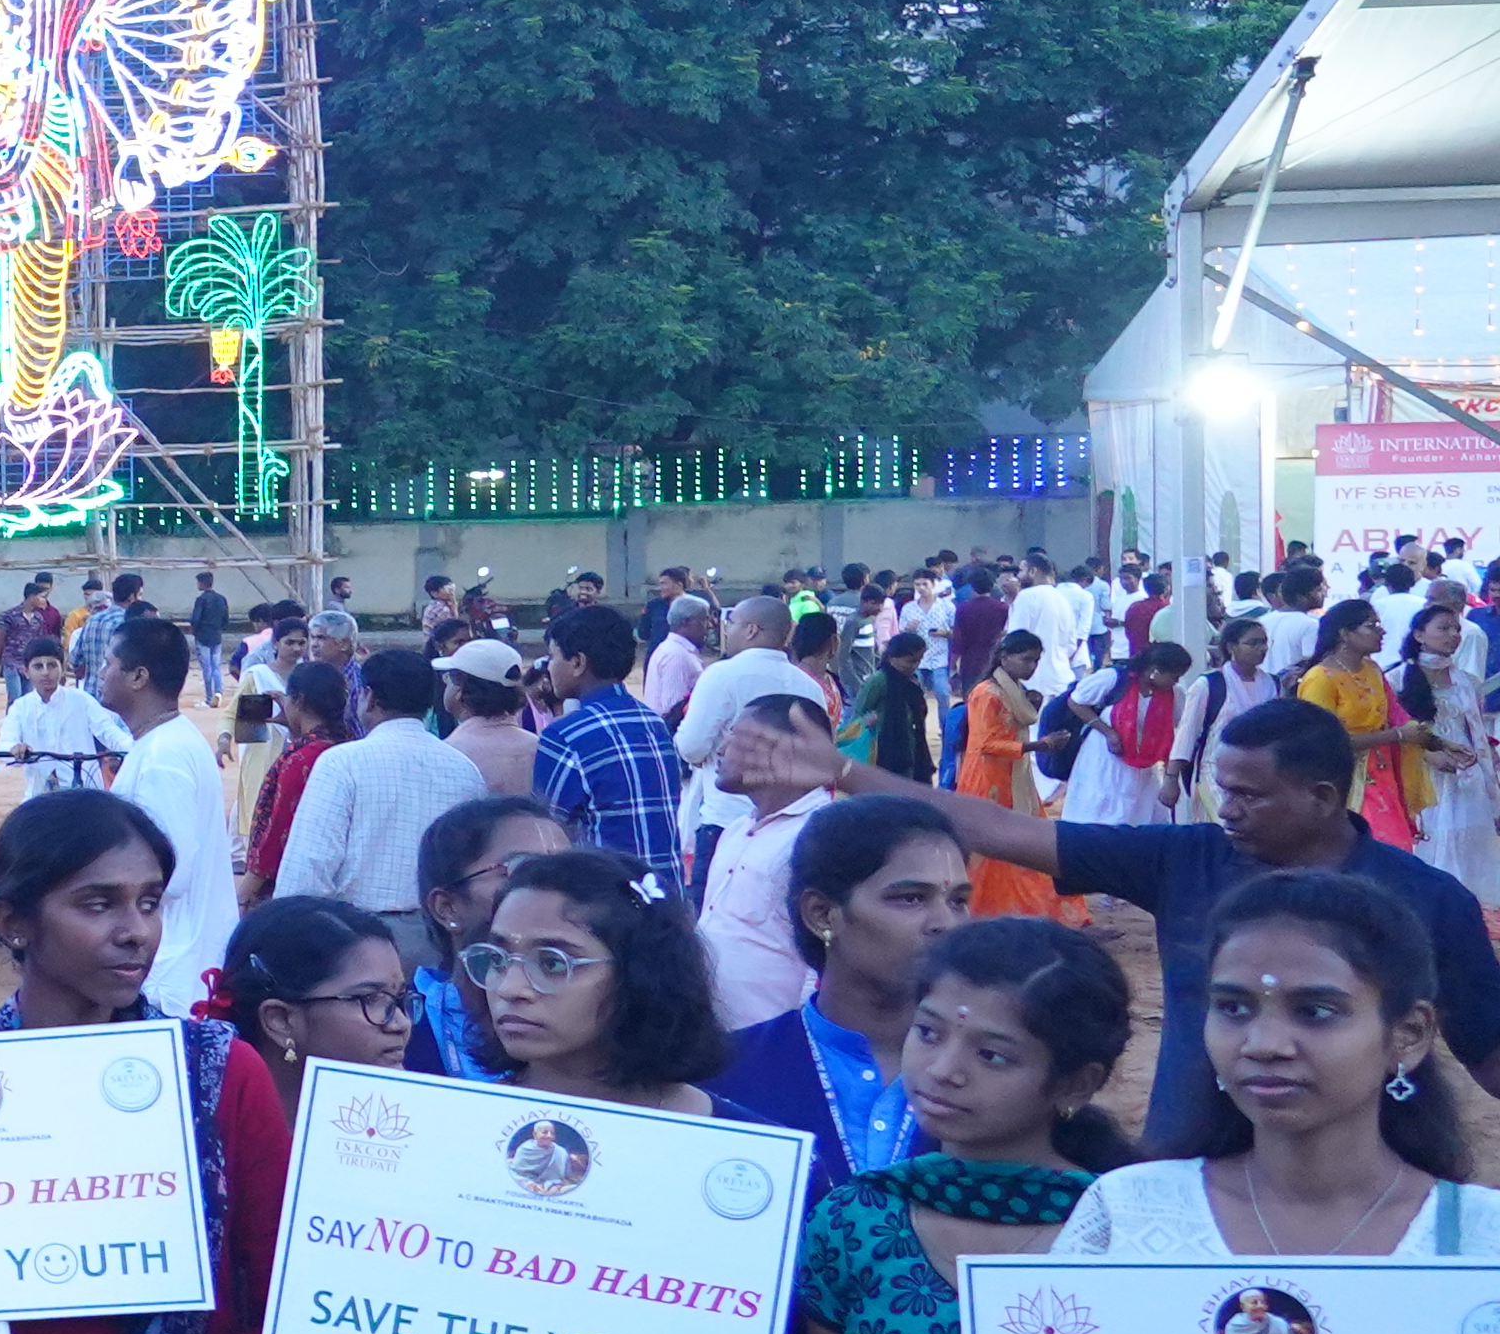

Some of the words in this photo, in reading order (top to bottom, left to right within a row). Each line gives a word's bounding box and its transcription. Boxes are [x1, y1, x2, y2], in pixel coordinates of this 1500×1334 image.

[1335, 487, 1367, 500] IYF
[334, 1139, 402, 1161] ISKCON
[494, 1109, 551, 1153] ABHAY
[559, 1111, 603, 1168] UTSAV
[336, 1153, 398, 1174] TIRUPATI
[27, 1170, 179, 1205] HABITS
[306, 1214, 365, 1251] SAY
[364, 1215, 432, 1262] NO
[432, 1235, 476, 1270] TO
[483, 1246, 578, 1288] BAD
[588, 1263, 763, 1321] HABITS
[1198, 1275, 1256, 1334] ABHAY
[1265, 1275, 1333, 1334] UTSAV
